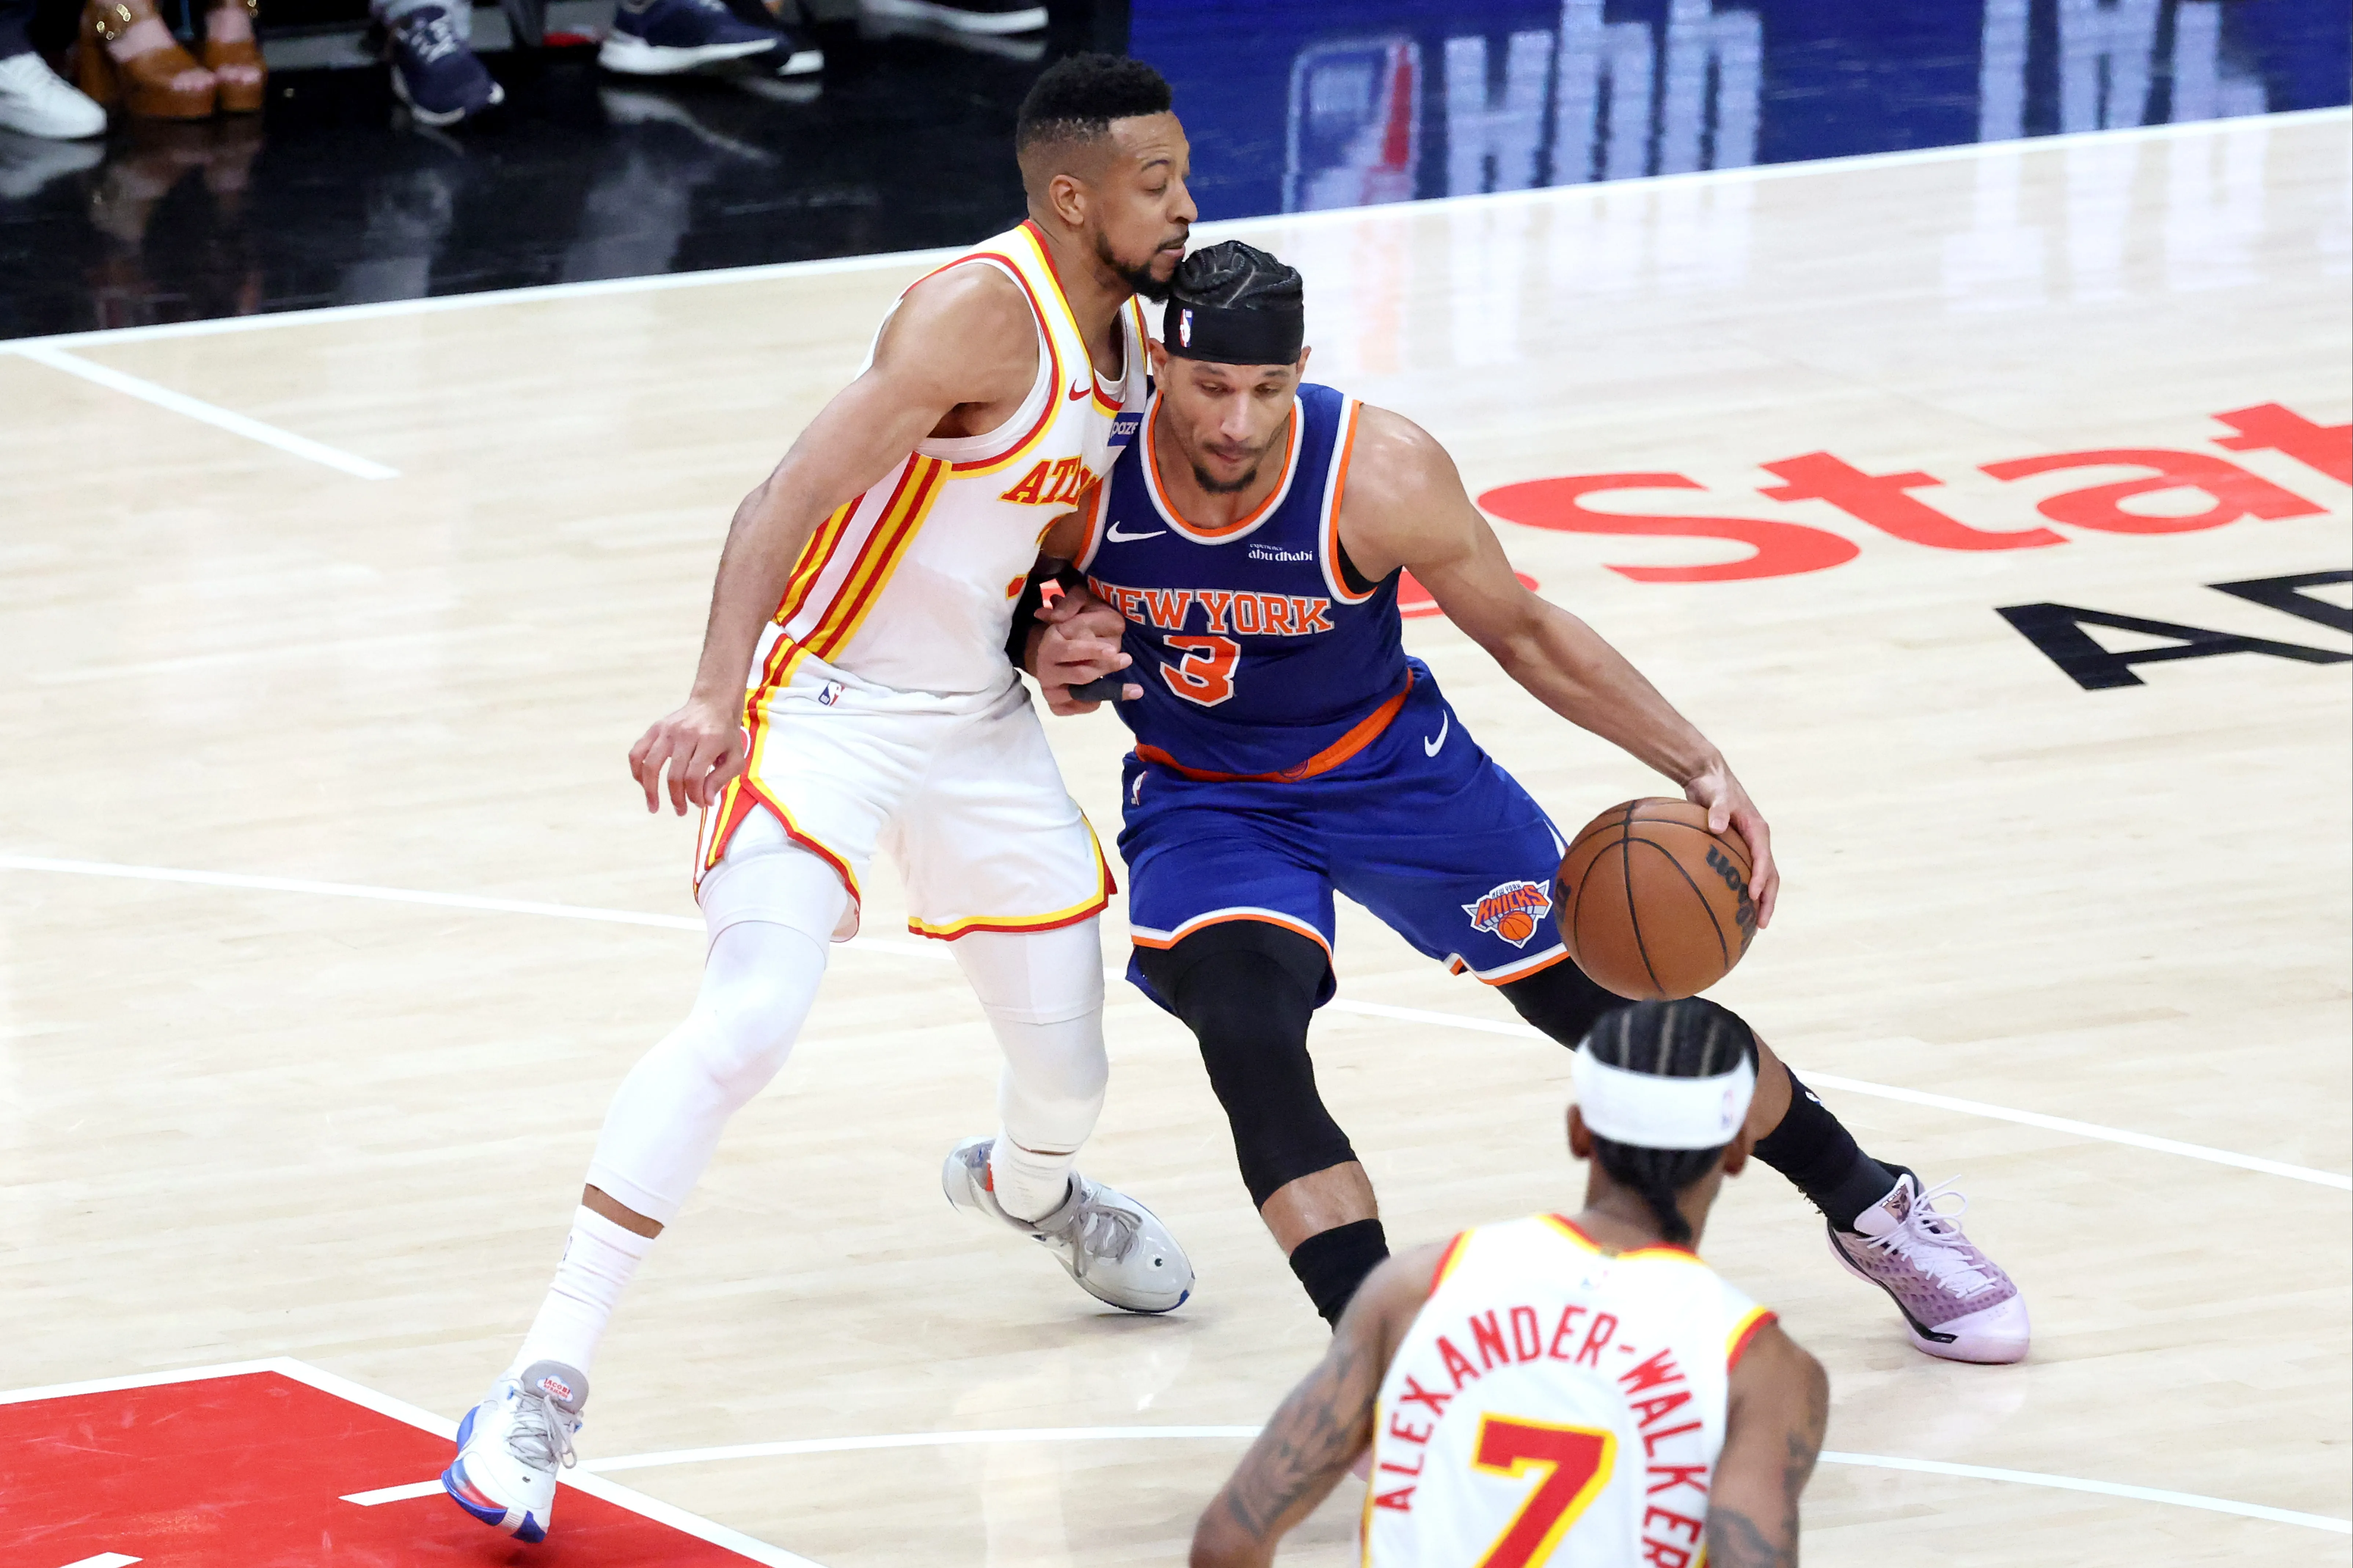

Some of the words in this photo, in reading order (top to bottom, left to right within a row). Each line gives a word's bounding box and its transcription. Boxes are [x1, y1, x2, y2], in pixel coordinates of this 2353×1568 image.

[1249, 549, 1273, 560] abu
[1275, 551, 1313, 561] dhabi
[1195, 589, 1335, 636] YORK
[1159, 635, 1241, 707] 3
[1475, 884, 1549, 926] KNICKS
[1492, 888, 1504, 899] NEW
[1505, 883, 1522, 893] YORK
[1471, 1410, 1619, 1568] 7
